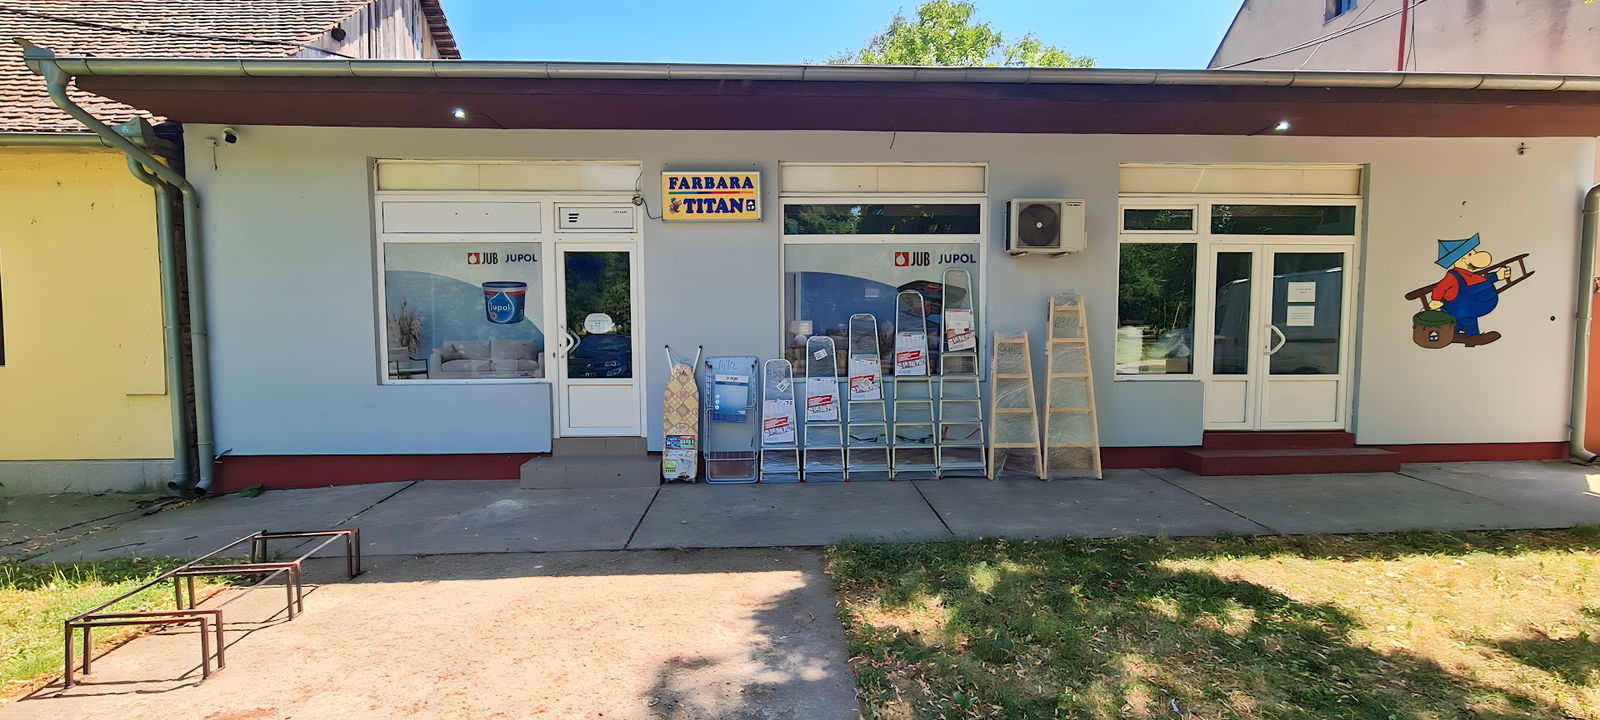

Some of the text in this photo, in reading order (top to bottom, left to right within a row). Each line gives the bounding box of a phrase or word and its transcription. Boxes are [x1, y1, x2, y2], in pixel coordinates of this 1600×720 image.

[668, 176, 754, 190] FARBARA
[683, 197, 744, 214] TITAN
[482, 252, 538, 265] JUB JUPOL
[911, 251, 976, 267] JUB JUPOL
